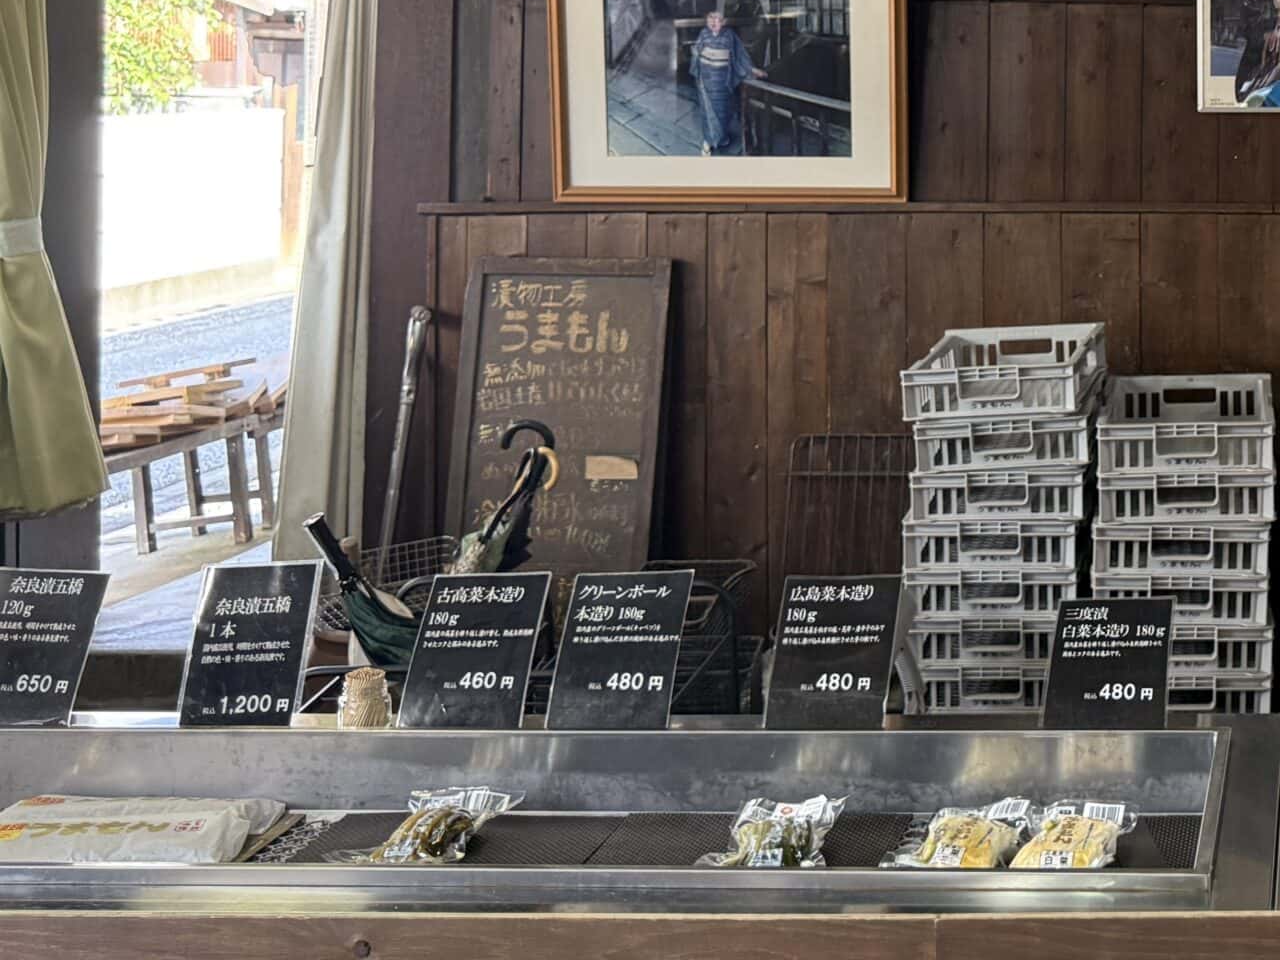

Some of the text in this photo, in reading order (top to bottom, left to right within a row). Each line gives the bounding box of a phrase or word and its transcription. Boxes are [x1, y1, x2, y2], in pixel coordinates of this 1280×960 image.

[491, 280, 589, 308] 漬物工房
[500, 310, 629, 354] うまもん
[9, 576, 84, 595] 奈良漬五橋
[578, 584, 672, 600] グリーンボール
[789, 584, 874, 602] 広島菜本造り
[437, 586, 525, 603] 古高菜本造り
[0, 600, 35, 618] 120g
[215, 596, 292, 616] 奈良漬五橋
[574, 605, 646, 622] 本造り 180g
[1064, 606, 1109, 621] 三度漬
[428, 611, 460, 626] 180g
[786, 608, 818, 623] 180g
[1062, 623, 1166, 638] 白菜本造り 180g
